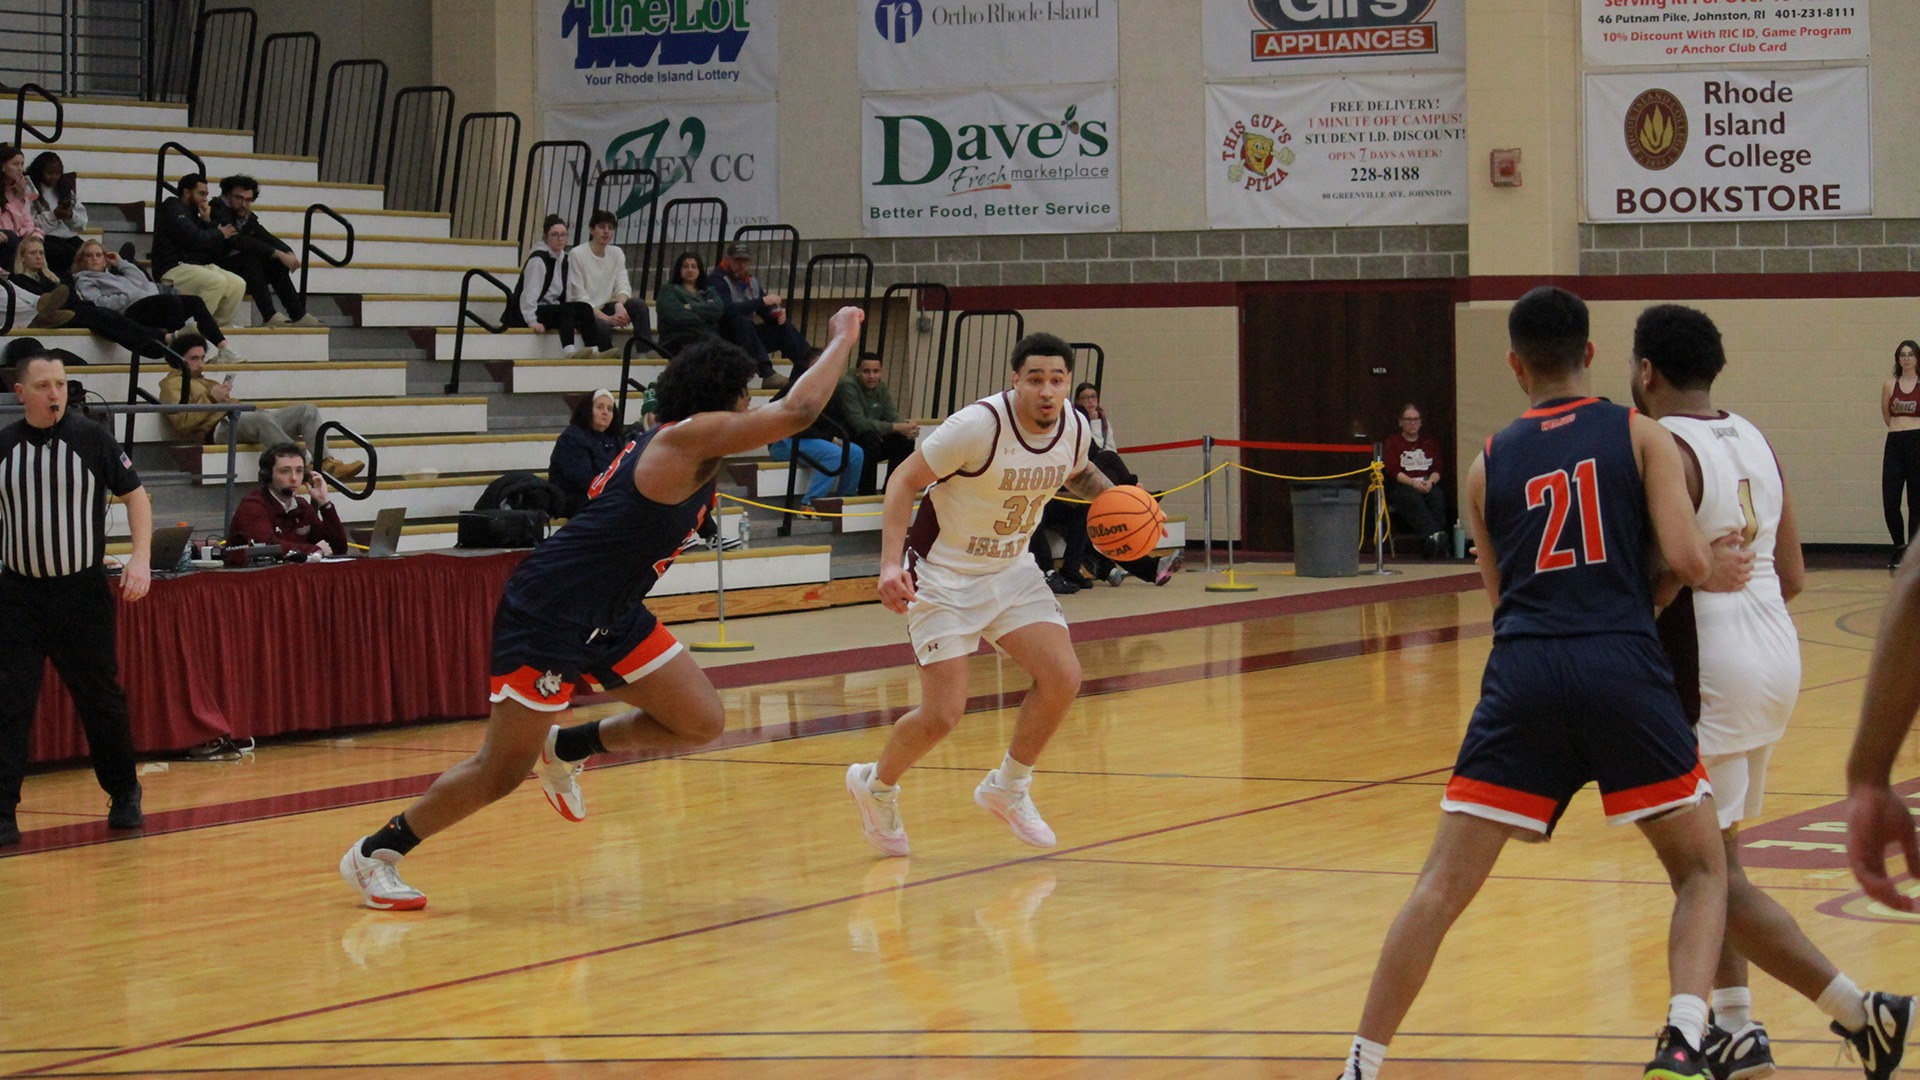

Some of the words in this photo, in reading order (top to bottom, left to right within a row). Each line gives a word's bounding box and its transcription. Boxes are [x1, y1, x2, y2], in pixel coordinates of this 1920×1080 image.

[932, 6, 984, 26] Ortho
[987, 2, 1043, 24] Rhode
[1047, 0, 1099, 20] Island
[1598, 15, 1612, 24] 46
[1616, 14, 1659, 23] Putnam
[1663, 13, 1690, 23] Pike,
[1693, 11, 1750, 21] Johnston,
[1754, 10, 1765, 19] RI
[1775, 7, 1855, 19] 401-231-8111
[1263, 29, 1425, 54] APPLIANCES
[1603, 32, 1628, 42] 10%
[1631, 31, 1683, 41] Discount
[1687, 30, 1716, 40] With
[1719, 28, 1739, 39] RIC
[1743, 28, 1759, 39] ID,
[1762, 27, 1797, 38] Game
[1800, 27, 1851, 39] Program
[1665, 47, 1678, 55] or
[1681, 44, 1726, 54] Anchor
[1729, 43, 1756, 53] Club
[1759, 42, 1787, 52] Card
[585, 74, 612, 86] Your
[615, 72, 654, 84] Rhode
[657, 70, 693, 83] Island
[697, 69, 740, 82] Lottery
[1704, 80, 1793, 104] Rhode
[1330, 101, 1364, 113] FREE
[1367, 98, 1440, 111] DELIVERY!
[1317, 115, 1370, 128] MINUTE
[1373, 114, 1399, 127] OFF
[1402, 113, 1463, 125] CAMPUS!
[1704, 111, 1786, 136] Island
[872, 110, 1109, 186] Dave's
[1222, 120, 1246, 161] THIS
[1250, 113, 1292, 144] GUY'S
[1304, 132, 1366, 145] STUDENT
[1369, 131, 1390, 143] I.D.
[1393, 128, 1466, 142] DISCOUNT!
[1328, 151, 1356, 161] OPEN
[1359, 147, 1367, 162] 7
[1370, 150, 1396, 160] DAYS
[1399, 151, 1405, 159] A
[1407, 149, 1443, 159] WEEK!
[1704, 143, 1812, 174] College
[568, 154, 701, 188] VALLEY
[710, 152, 755, 183] CC
[948, 165, 1006, 192] Fresh
[1010, 163, 1109, 182] marketplace
[1244, 167, 1289, 192] PIZZA
[1350, 166, 1420, 182] 228-8188
[1332, 191, 1386, 200] GREENVILLE
[1408, 189, 1452, 198] JOHNSTON
[1616, 184, 1841, 214] BOOKSTORE
[692, 217, 731, 226] SPECIL
[870, 206, 923, 219] Better
[930, 205, 977, 219] Food,
[984, 203, 1039, 217] Better
[1045, 202, 1111, 215] Service
[998, 465, 1067, 492] RHODE
[993, 494, 1046, 536] 31
[1525, 458, 1607, 574] 21
[1737, 478, 1759, 548] 1
